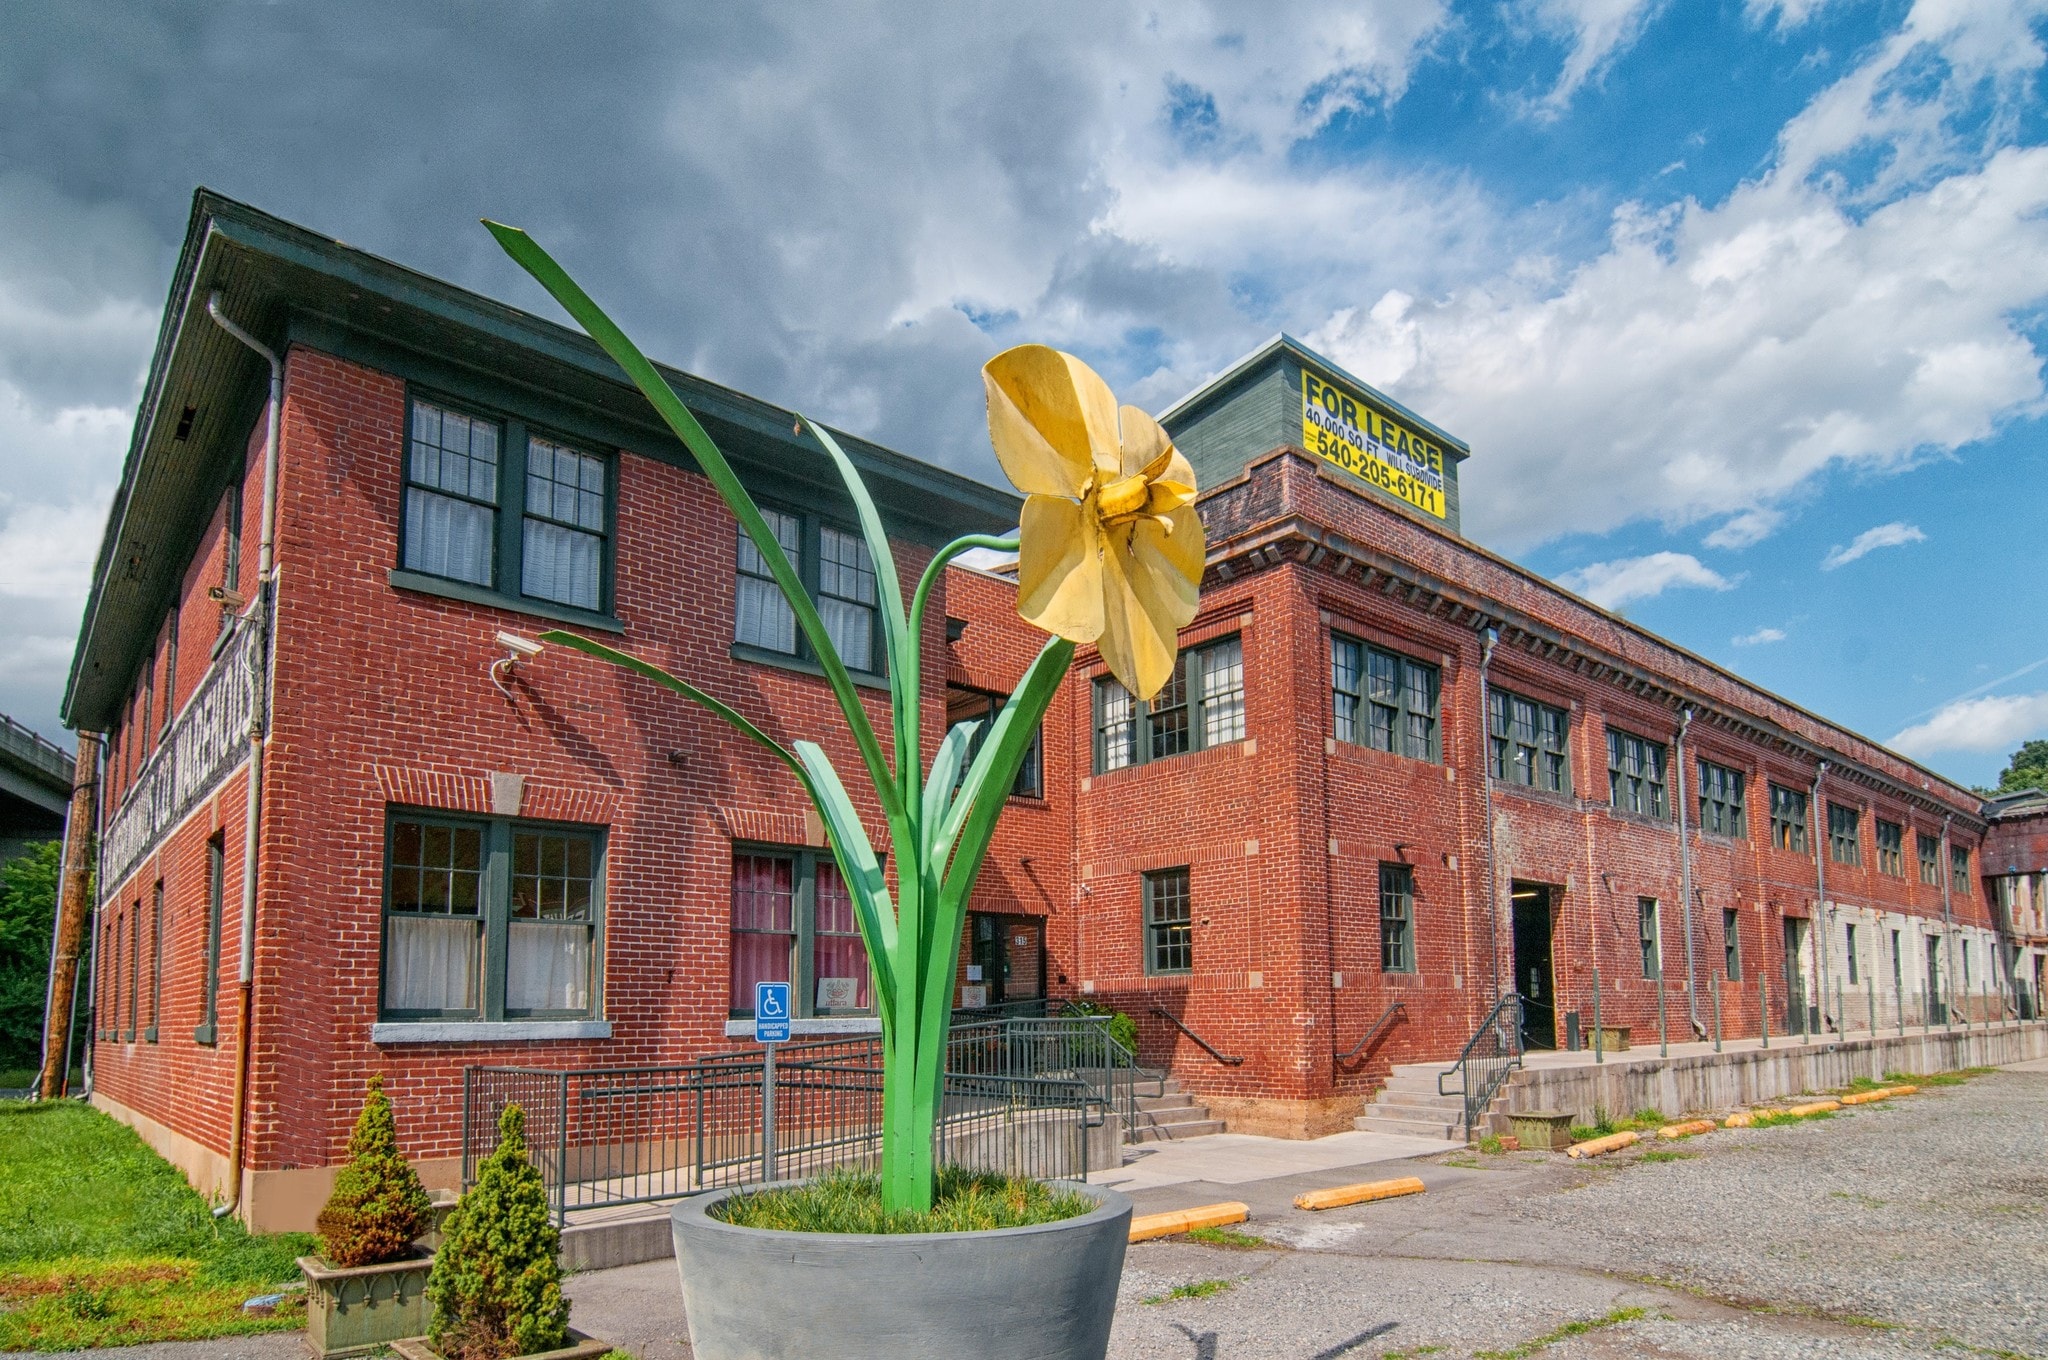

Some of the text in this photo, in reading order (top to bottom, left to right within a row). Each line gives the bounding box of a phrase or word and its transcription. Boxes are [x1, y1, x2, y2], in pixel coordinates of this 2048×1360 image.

[1306, 375, 1440, 477] FOR LEASE
[1306, 407, 1345, 441] 40,000
[1348, 431, 1363, 451] SQ
[1366, 441, 1378, 460] FT
[1386, 451, 1404, 474] WILL
[1405, 463, 1442, 493] SUBDIVIDE
[1317, 431, 1435, 512] 540-205-6171
[174, 625, 257, 810] WAREHOUS
[758, 1022, 788, 1030] HANDICAPPED
